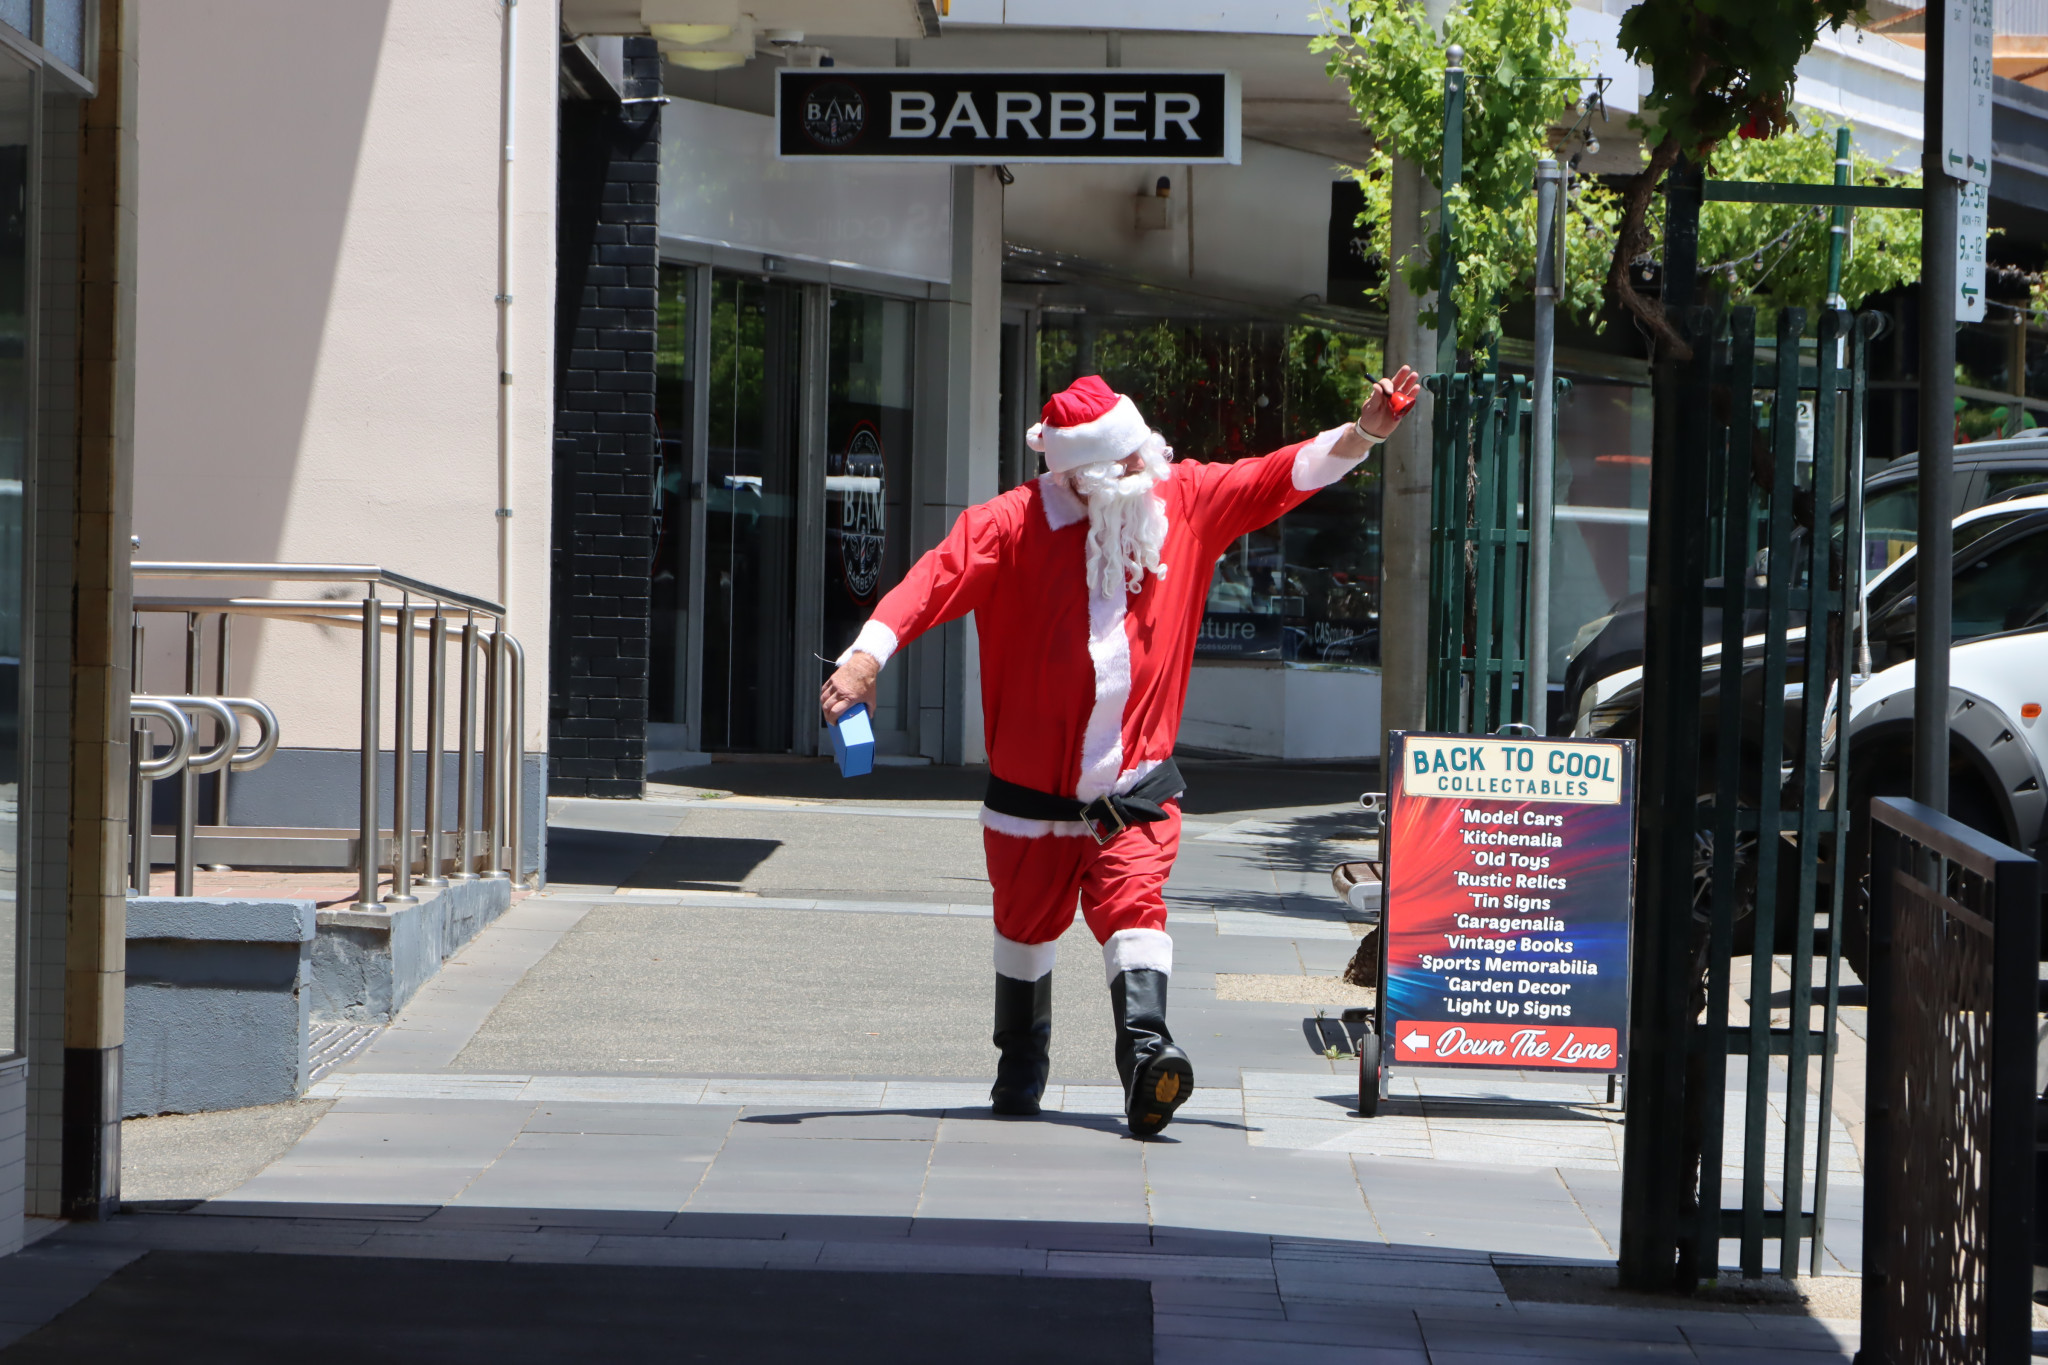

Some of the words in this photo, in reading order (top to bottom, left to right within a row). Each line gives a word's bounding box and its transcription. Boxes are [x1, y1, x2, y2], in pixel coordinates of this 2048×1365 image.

[807, 97, 862, 122] BAM
[889, 91, 1202, 142] BARBER
[1412, 746, 1485, 775] BACK
[1501, 746, 1534, 773] TO
[1549, 750, 1616, 783] COOL
[1438, 776, 1589, 797] COLLECTABLES
[1463, 808, 1519, 825] Model
[1523, 811, 1563, 827] Cars
[1463, 829, 1563, 848] Kitchenalia
[1475, 850, 1506, 867] Old
[1509, 852, 1550, 871] Toys
[1457, 871, 1512, 888] Rustic
[1515, 873, 1567, 890] Relics
[1472, 893, 1500, 909] Tin
[1503, 894, 1551, 912] Signs
[1448, 934, 1516, 954] Vintage
[1520, 936, 1574, 954] Books
[1422, 954, 1480, 973] Sports
[1485, 956, 1599, 976] Memorabilia
[1448, 976, 1514, 994] Garden
[1518, 978, 1571, 995] Decor
[1447, 998, 1492, 1017] Light
[1495, 1000, 1520, 1018] Up
[1523, 1000, 1572, 1020] Signs
[1435, 1027, 1506, 1058] Down
[1510, 1029, 1551, 1058] The
[1552, 1032, 1612, 1064] Lane
